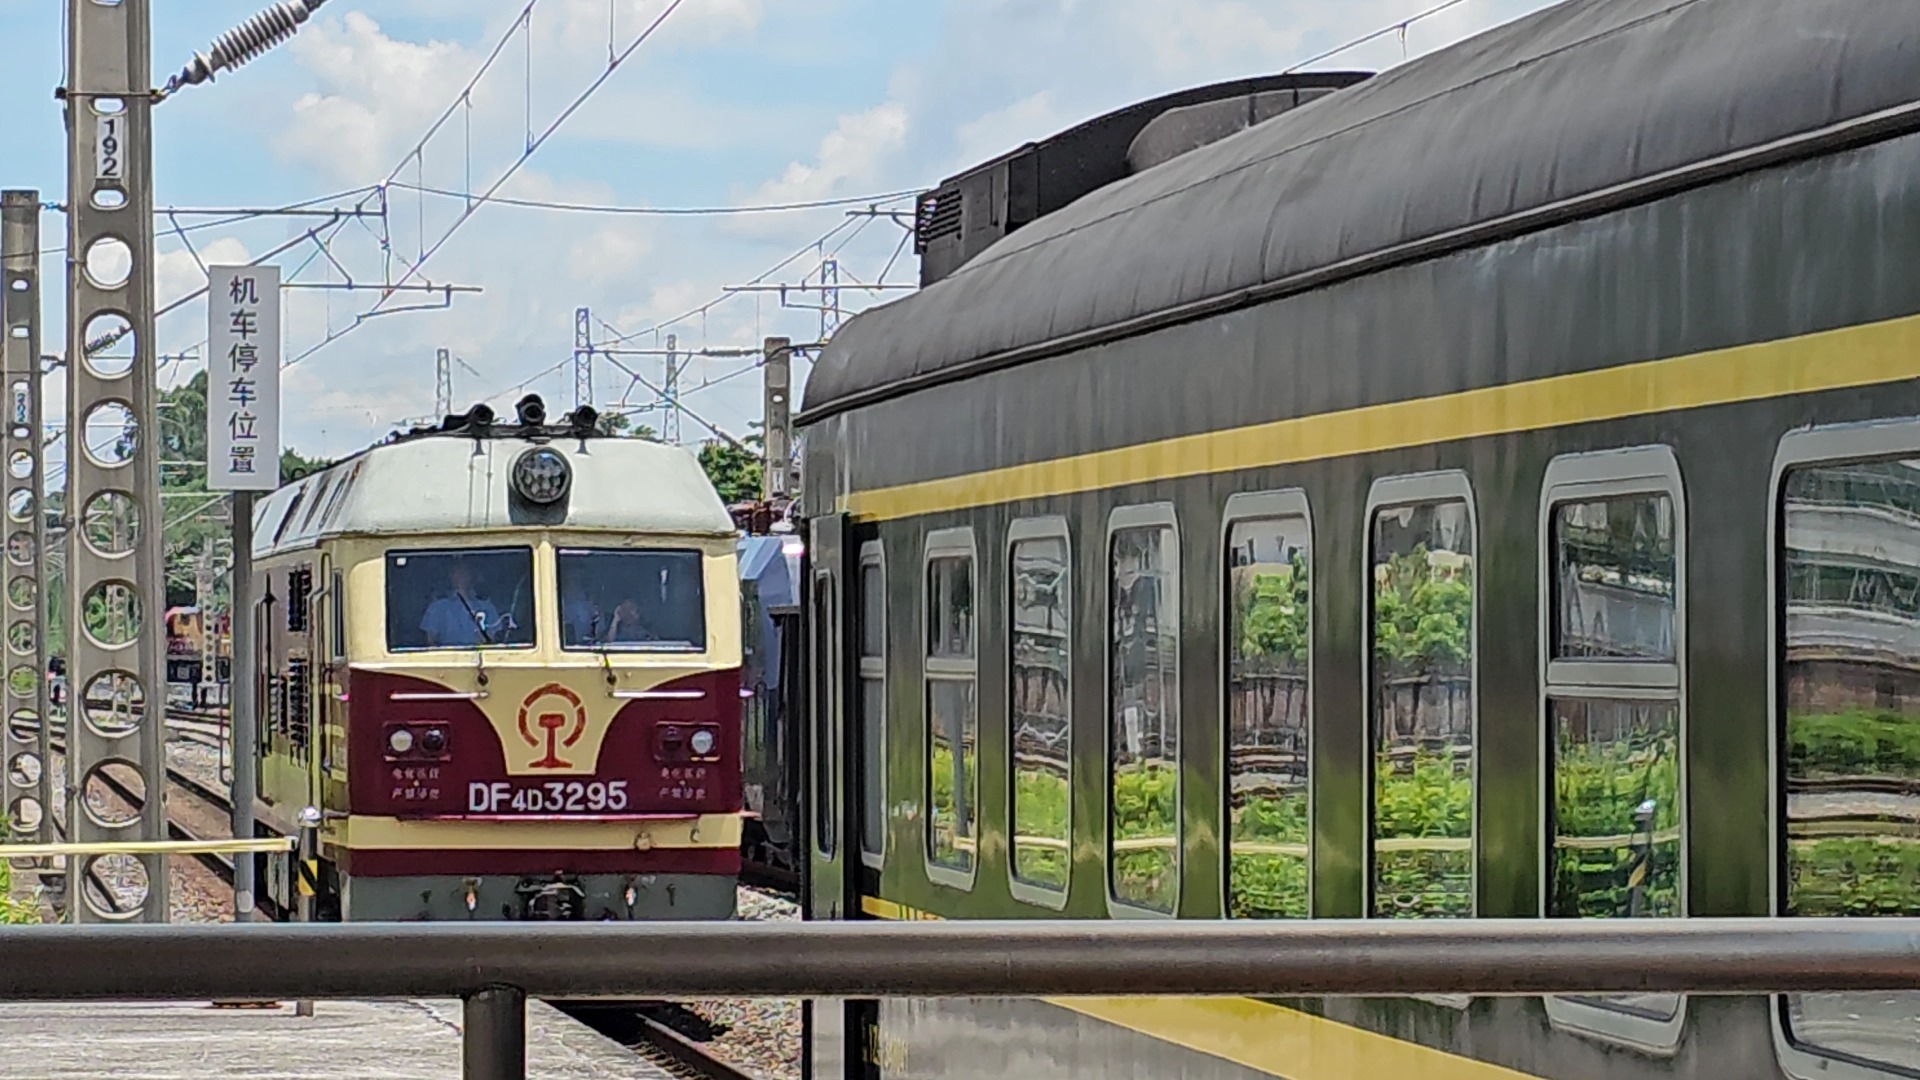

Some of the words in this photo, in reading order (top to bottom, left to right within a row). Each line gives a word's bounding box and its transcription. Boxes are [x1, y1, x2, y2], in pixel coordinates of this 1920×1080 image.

[101, 119, 118, 177] 192
[228, 275, 259, 473] 机车停车位置
[469, 781, 628, 812] DF4D3295
